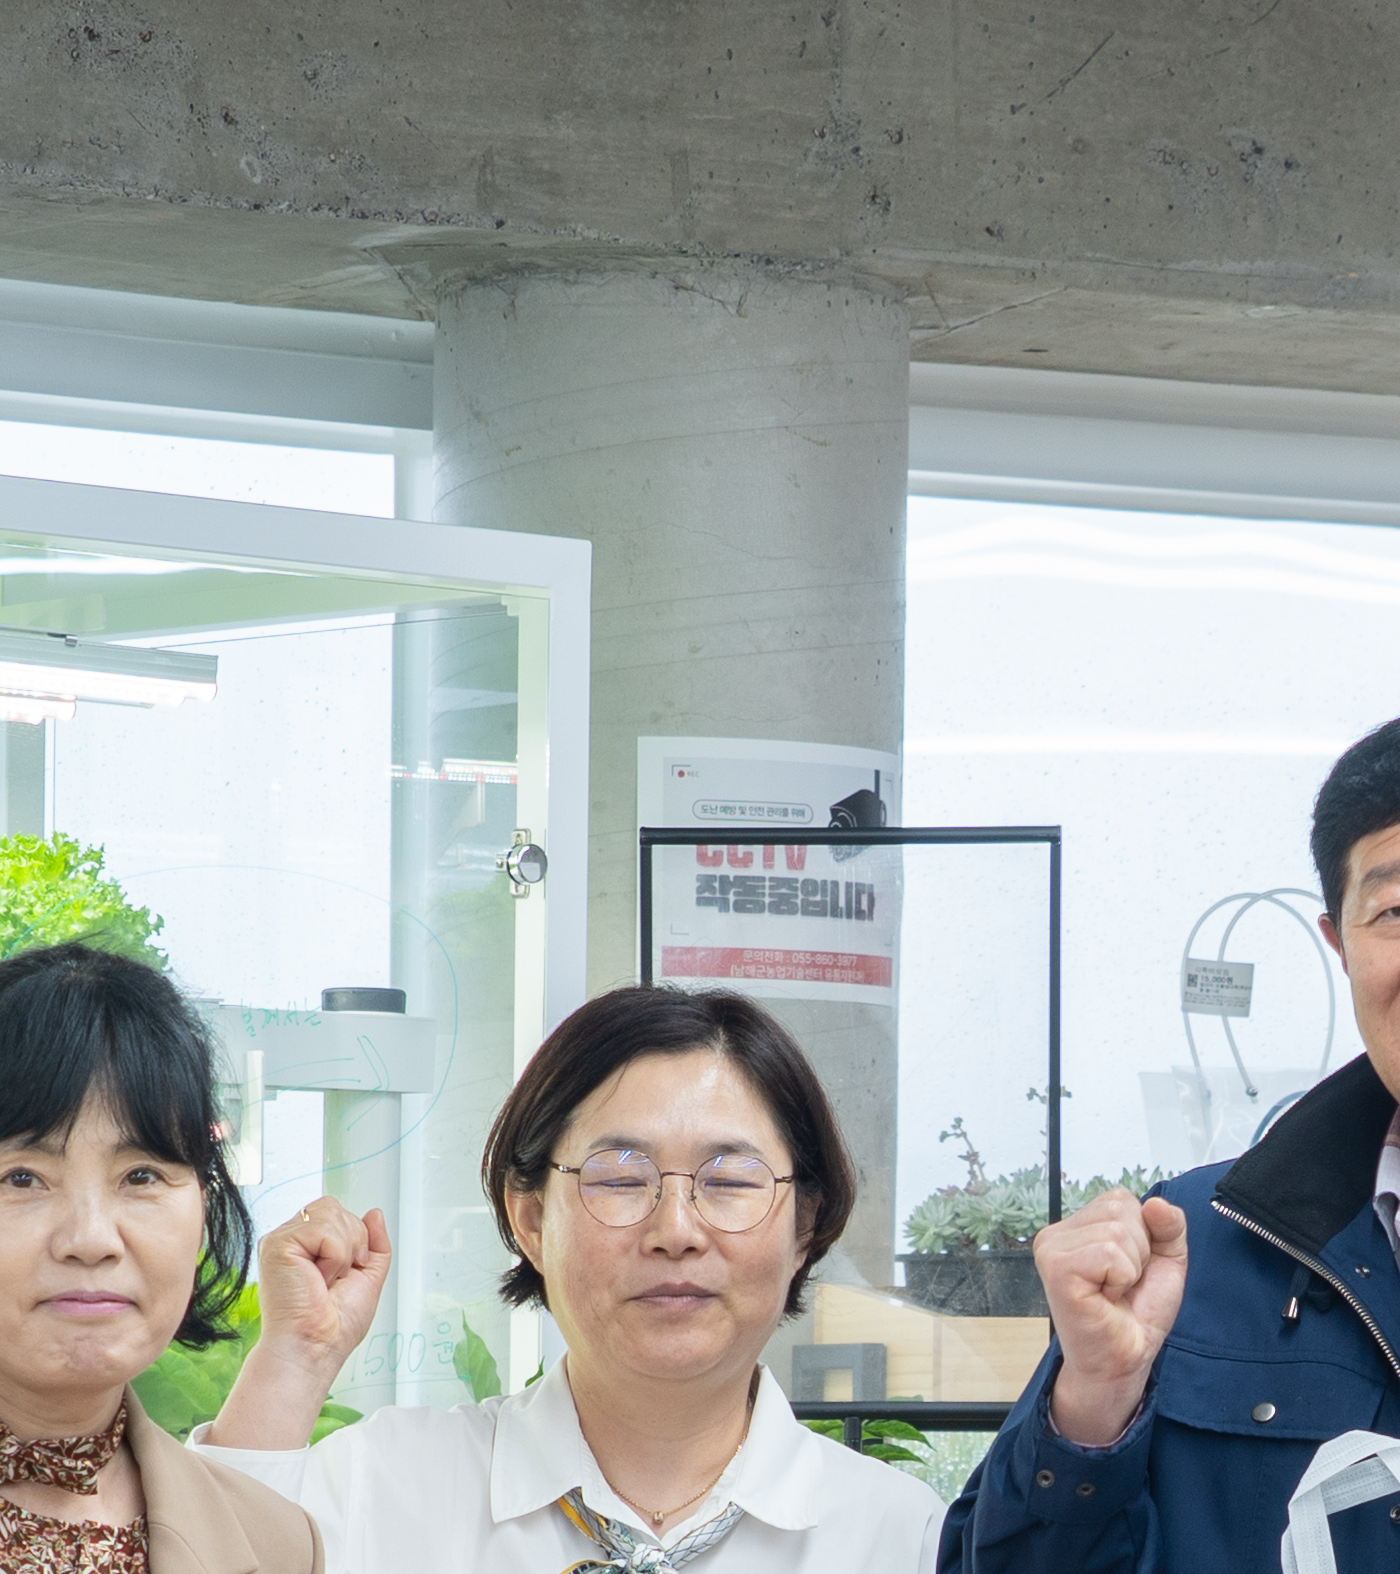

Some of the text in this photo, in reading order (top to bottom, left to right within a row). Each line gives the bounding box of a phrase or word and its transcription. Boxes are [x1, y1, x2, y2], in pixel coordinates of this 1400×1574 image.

[701, 805, 718, 815] 도난
[719, 805, 736, 816] 예방
[749, 806, 765, 817] 안전
[766, 807, 789, 818] 관리를
[790, 808, 805, 818] 위해
[695, 874, 875, 922] 작동중입니다
[743, 950, 784, 964] 문의전화
